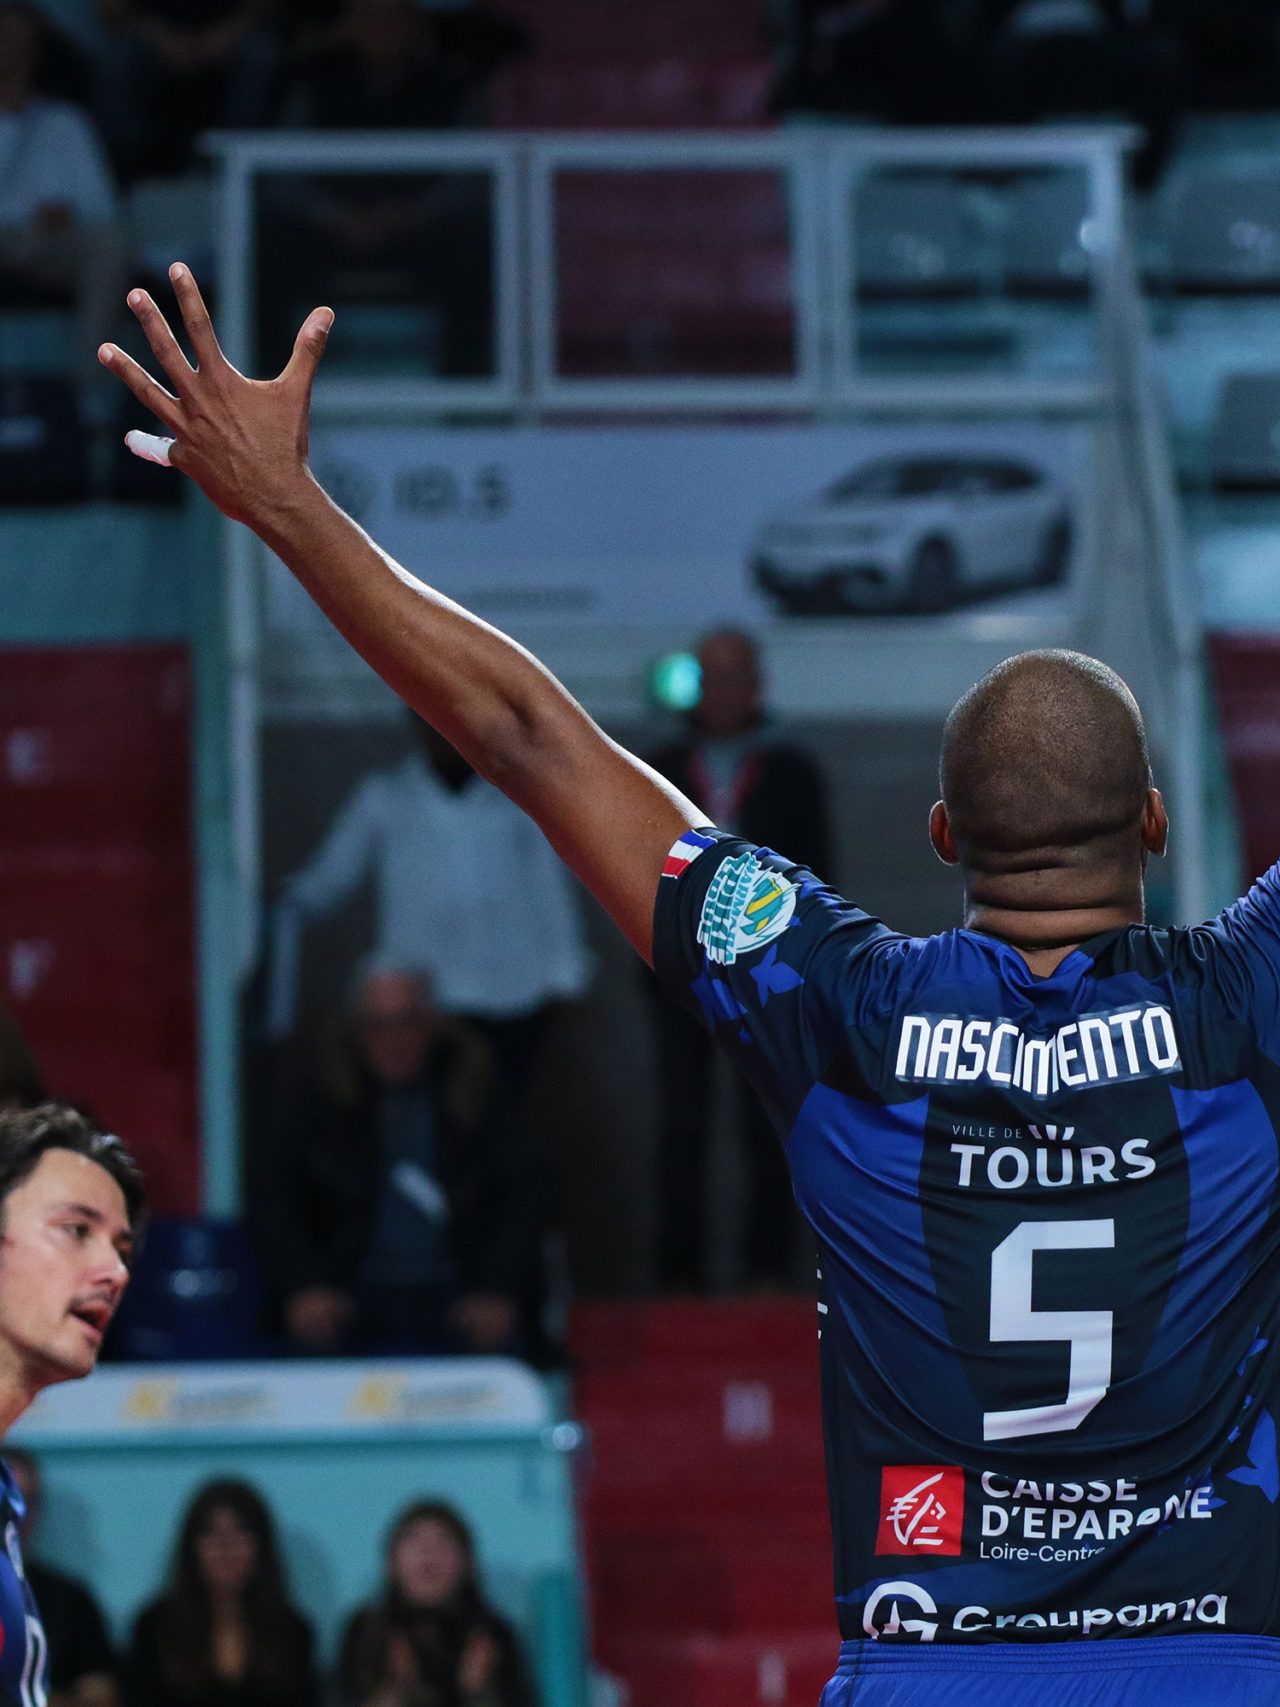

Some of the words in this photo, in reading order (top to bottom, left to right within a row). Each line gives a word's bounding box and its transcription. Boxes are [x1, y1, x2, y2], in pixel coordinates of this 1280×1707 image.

[894, 1006, 1179, 1096] NASCIMENTO
[951, 1124, 996, 1139] VILLE
[1003, 1127, 1023, 1139] DE
[950, 1138, 1157, 1189] TOURS
[983, 1218, 1116, 1442] 5
[980, 1470, 1138, 1503] CAISSE
[952, 1593, 1228, 1635] Groupama
